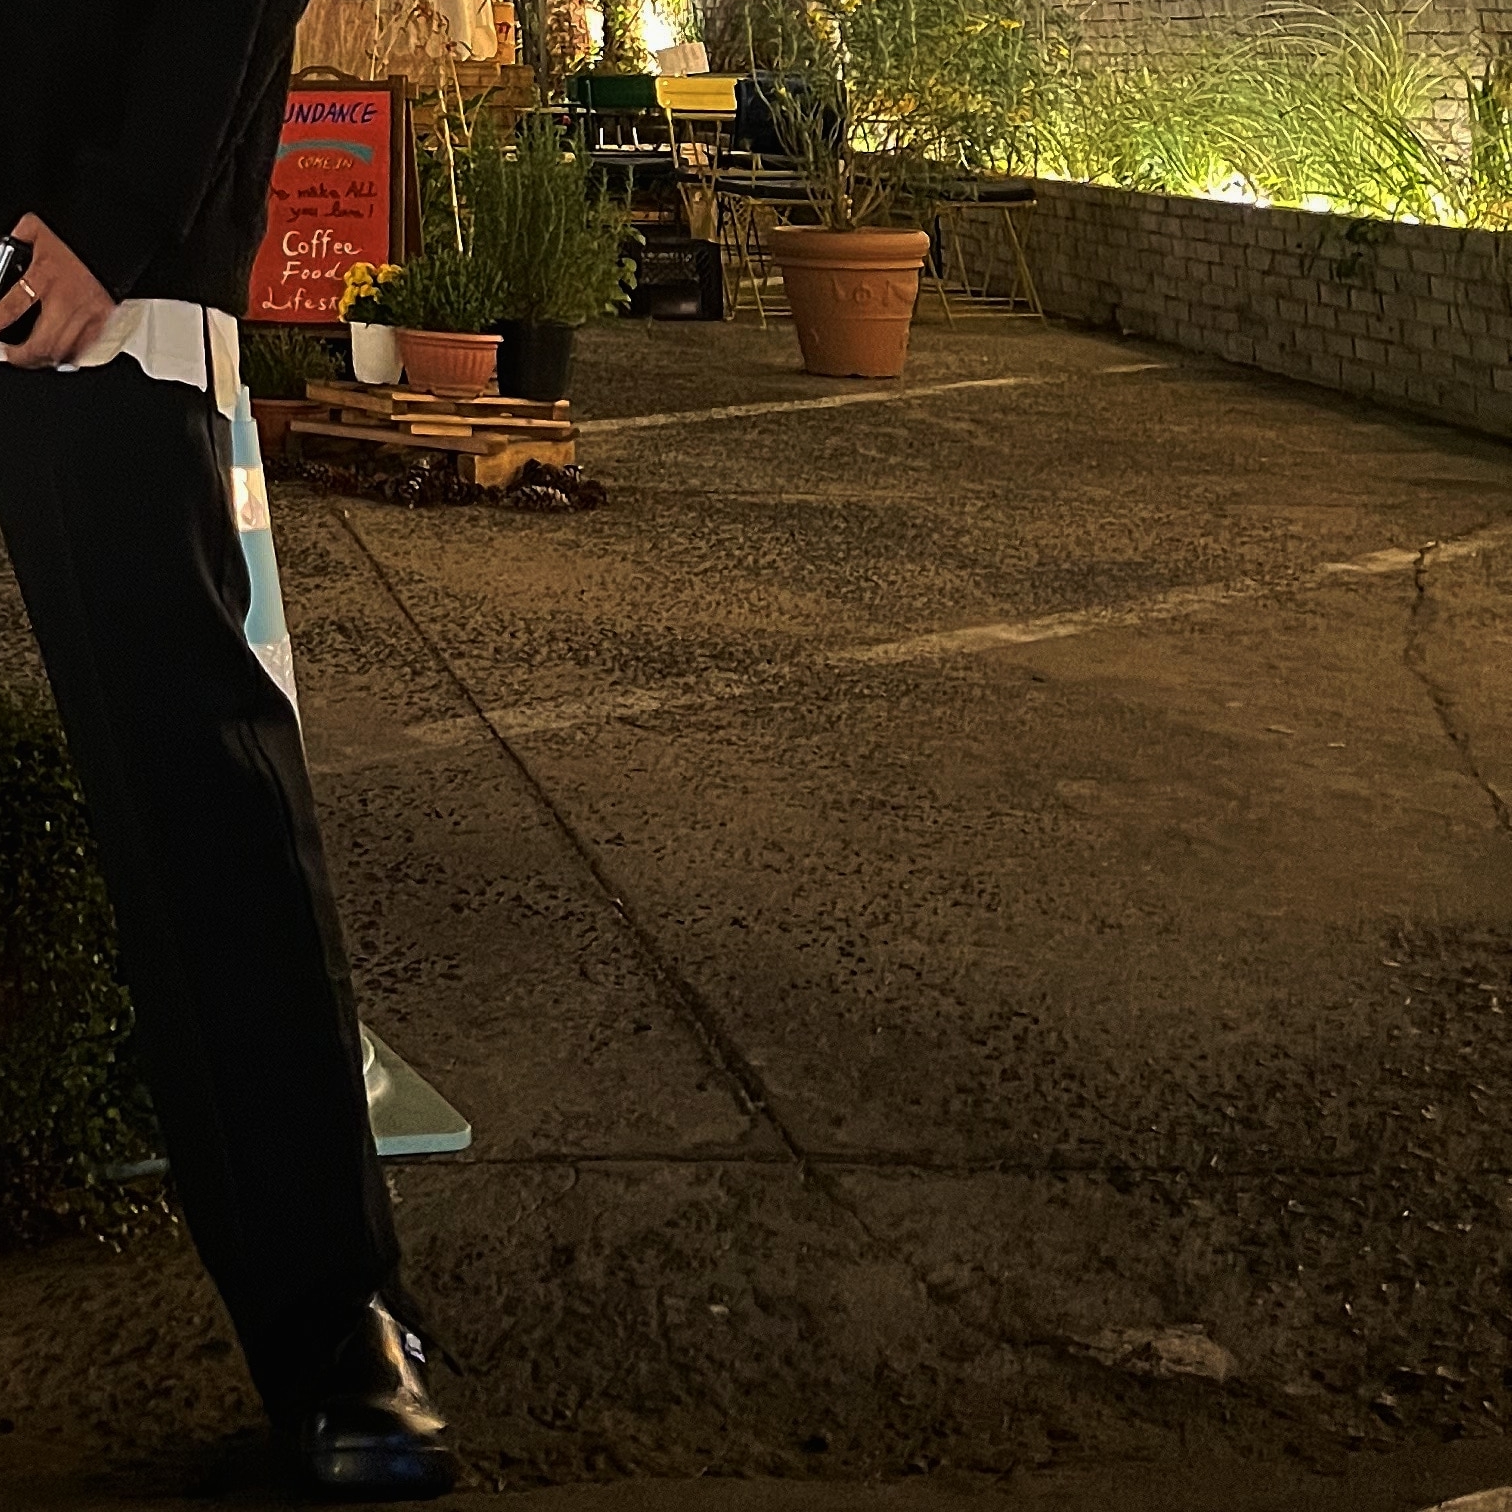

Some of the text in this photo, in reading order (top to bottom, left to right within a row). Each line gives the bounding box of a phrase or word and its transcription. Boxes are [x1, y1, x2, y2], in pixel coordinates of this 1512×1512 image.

[283, 102, 378, 124] UNDANCE
[297, 155, 354, 169] COME IN
[282, 229, 363, 259] Coffee
[281, 261, 344, 285] Food
[262, 287, 340, 312] Lifest
